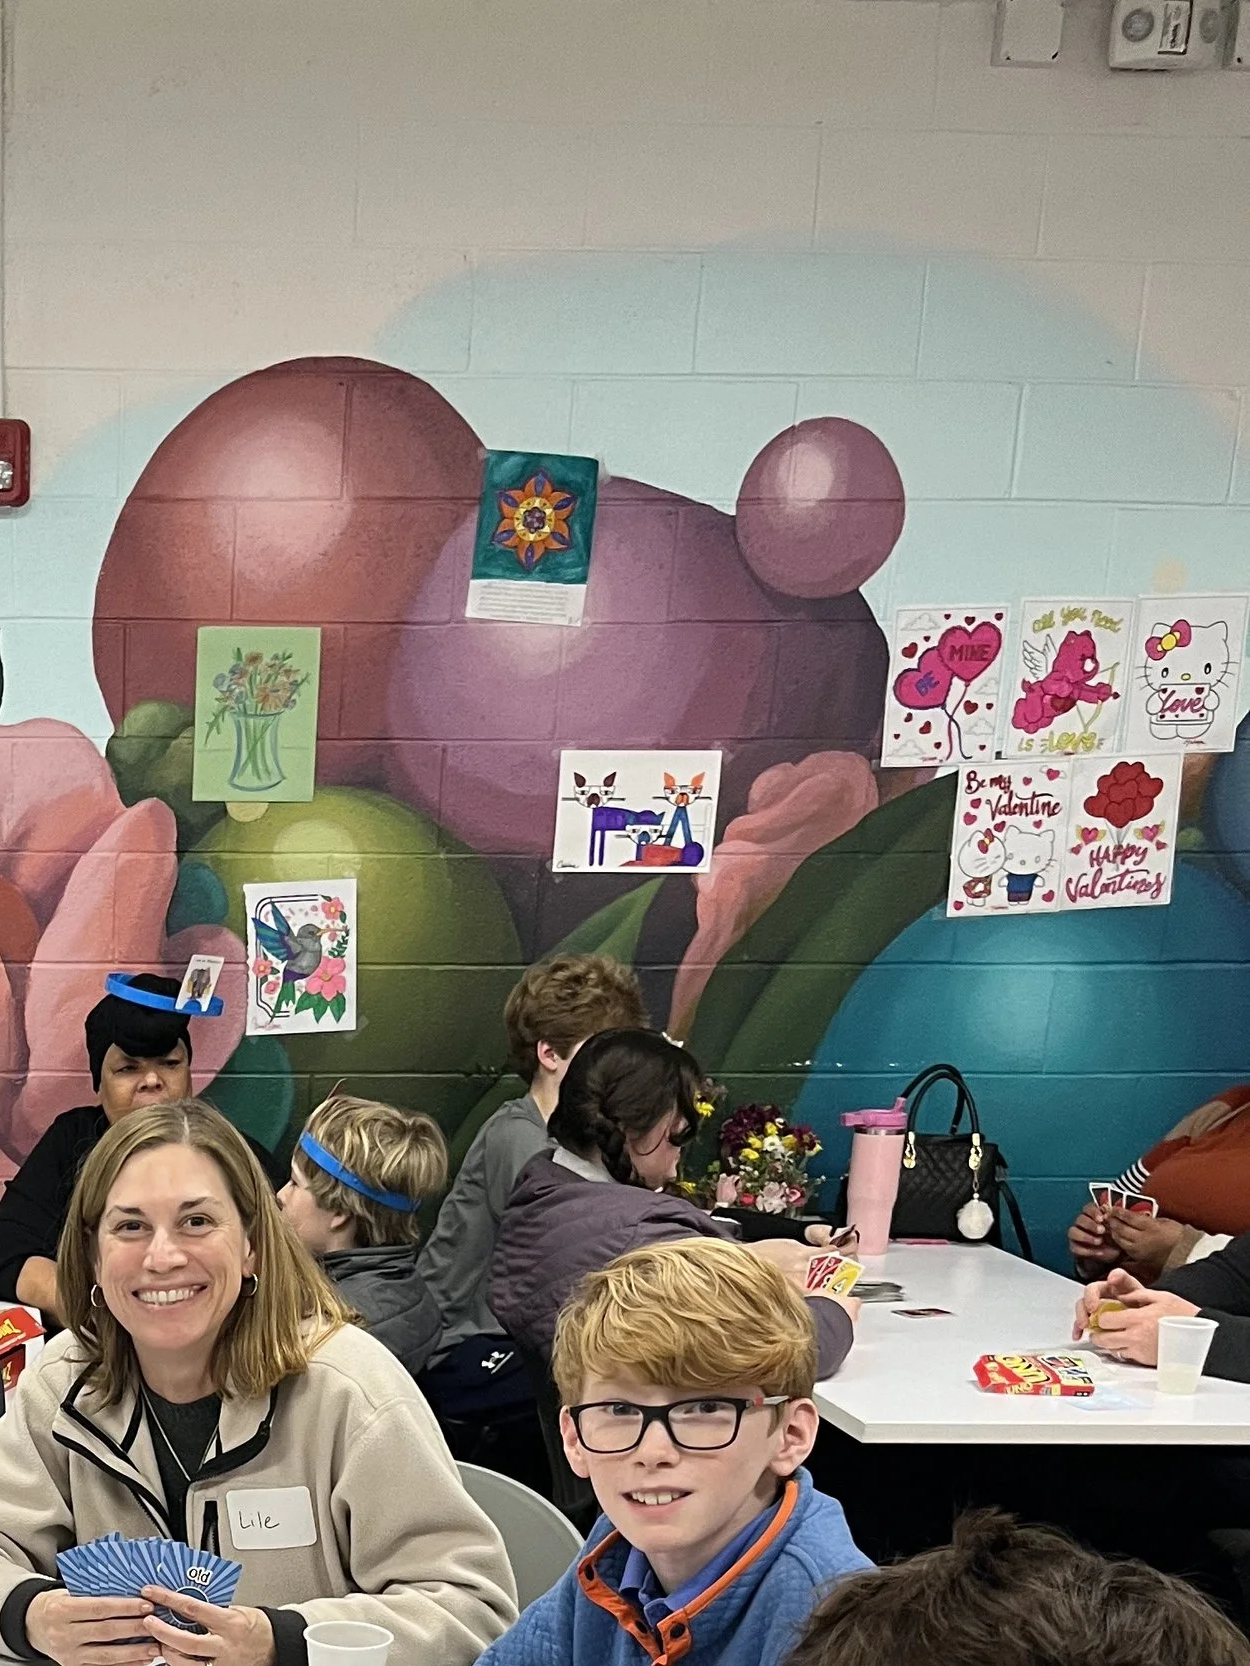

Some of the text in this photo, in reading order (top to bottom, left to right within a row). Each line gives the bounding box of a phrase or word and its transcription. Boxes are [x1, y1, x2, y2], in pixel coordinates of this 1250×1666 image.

[950, 644, 990, 662] MINE
[915, 672, 940, 697] BE
[965, 770, 1012, 794] Be my
[986, 792, 1063, 821] Valentine
[239, 1511, 279, 1530] Lile
[188, 1567, 211, 1584] Old
